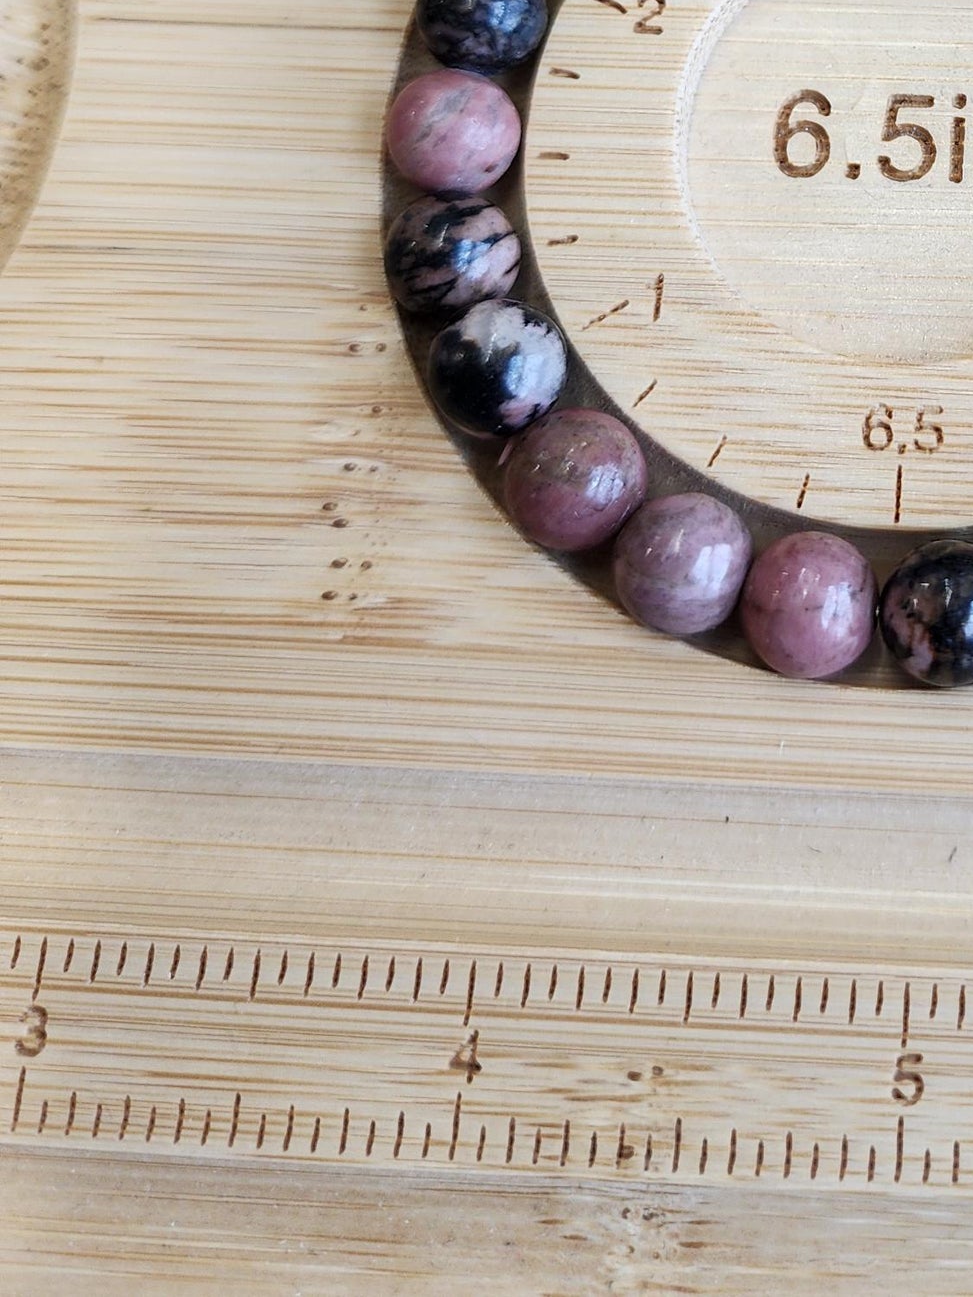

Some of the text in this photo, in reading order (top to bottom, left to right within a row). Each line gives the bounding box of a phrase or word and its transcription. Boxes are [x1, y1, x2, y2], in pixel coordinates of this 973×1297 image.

[652, 273, 665, 322] 1
[861, 403, 945, 455] 6.5
[14, 1005, 49, 1058] 3
[447, 1029, 484, 1085] 4
[892, 1052, 925, 1107] 5
